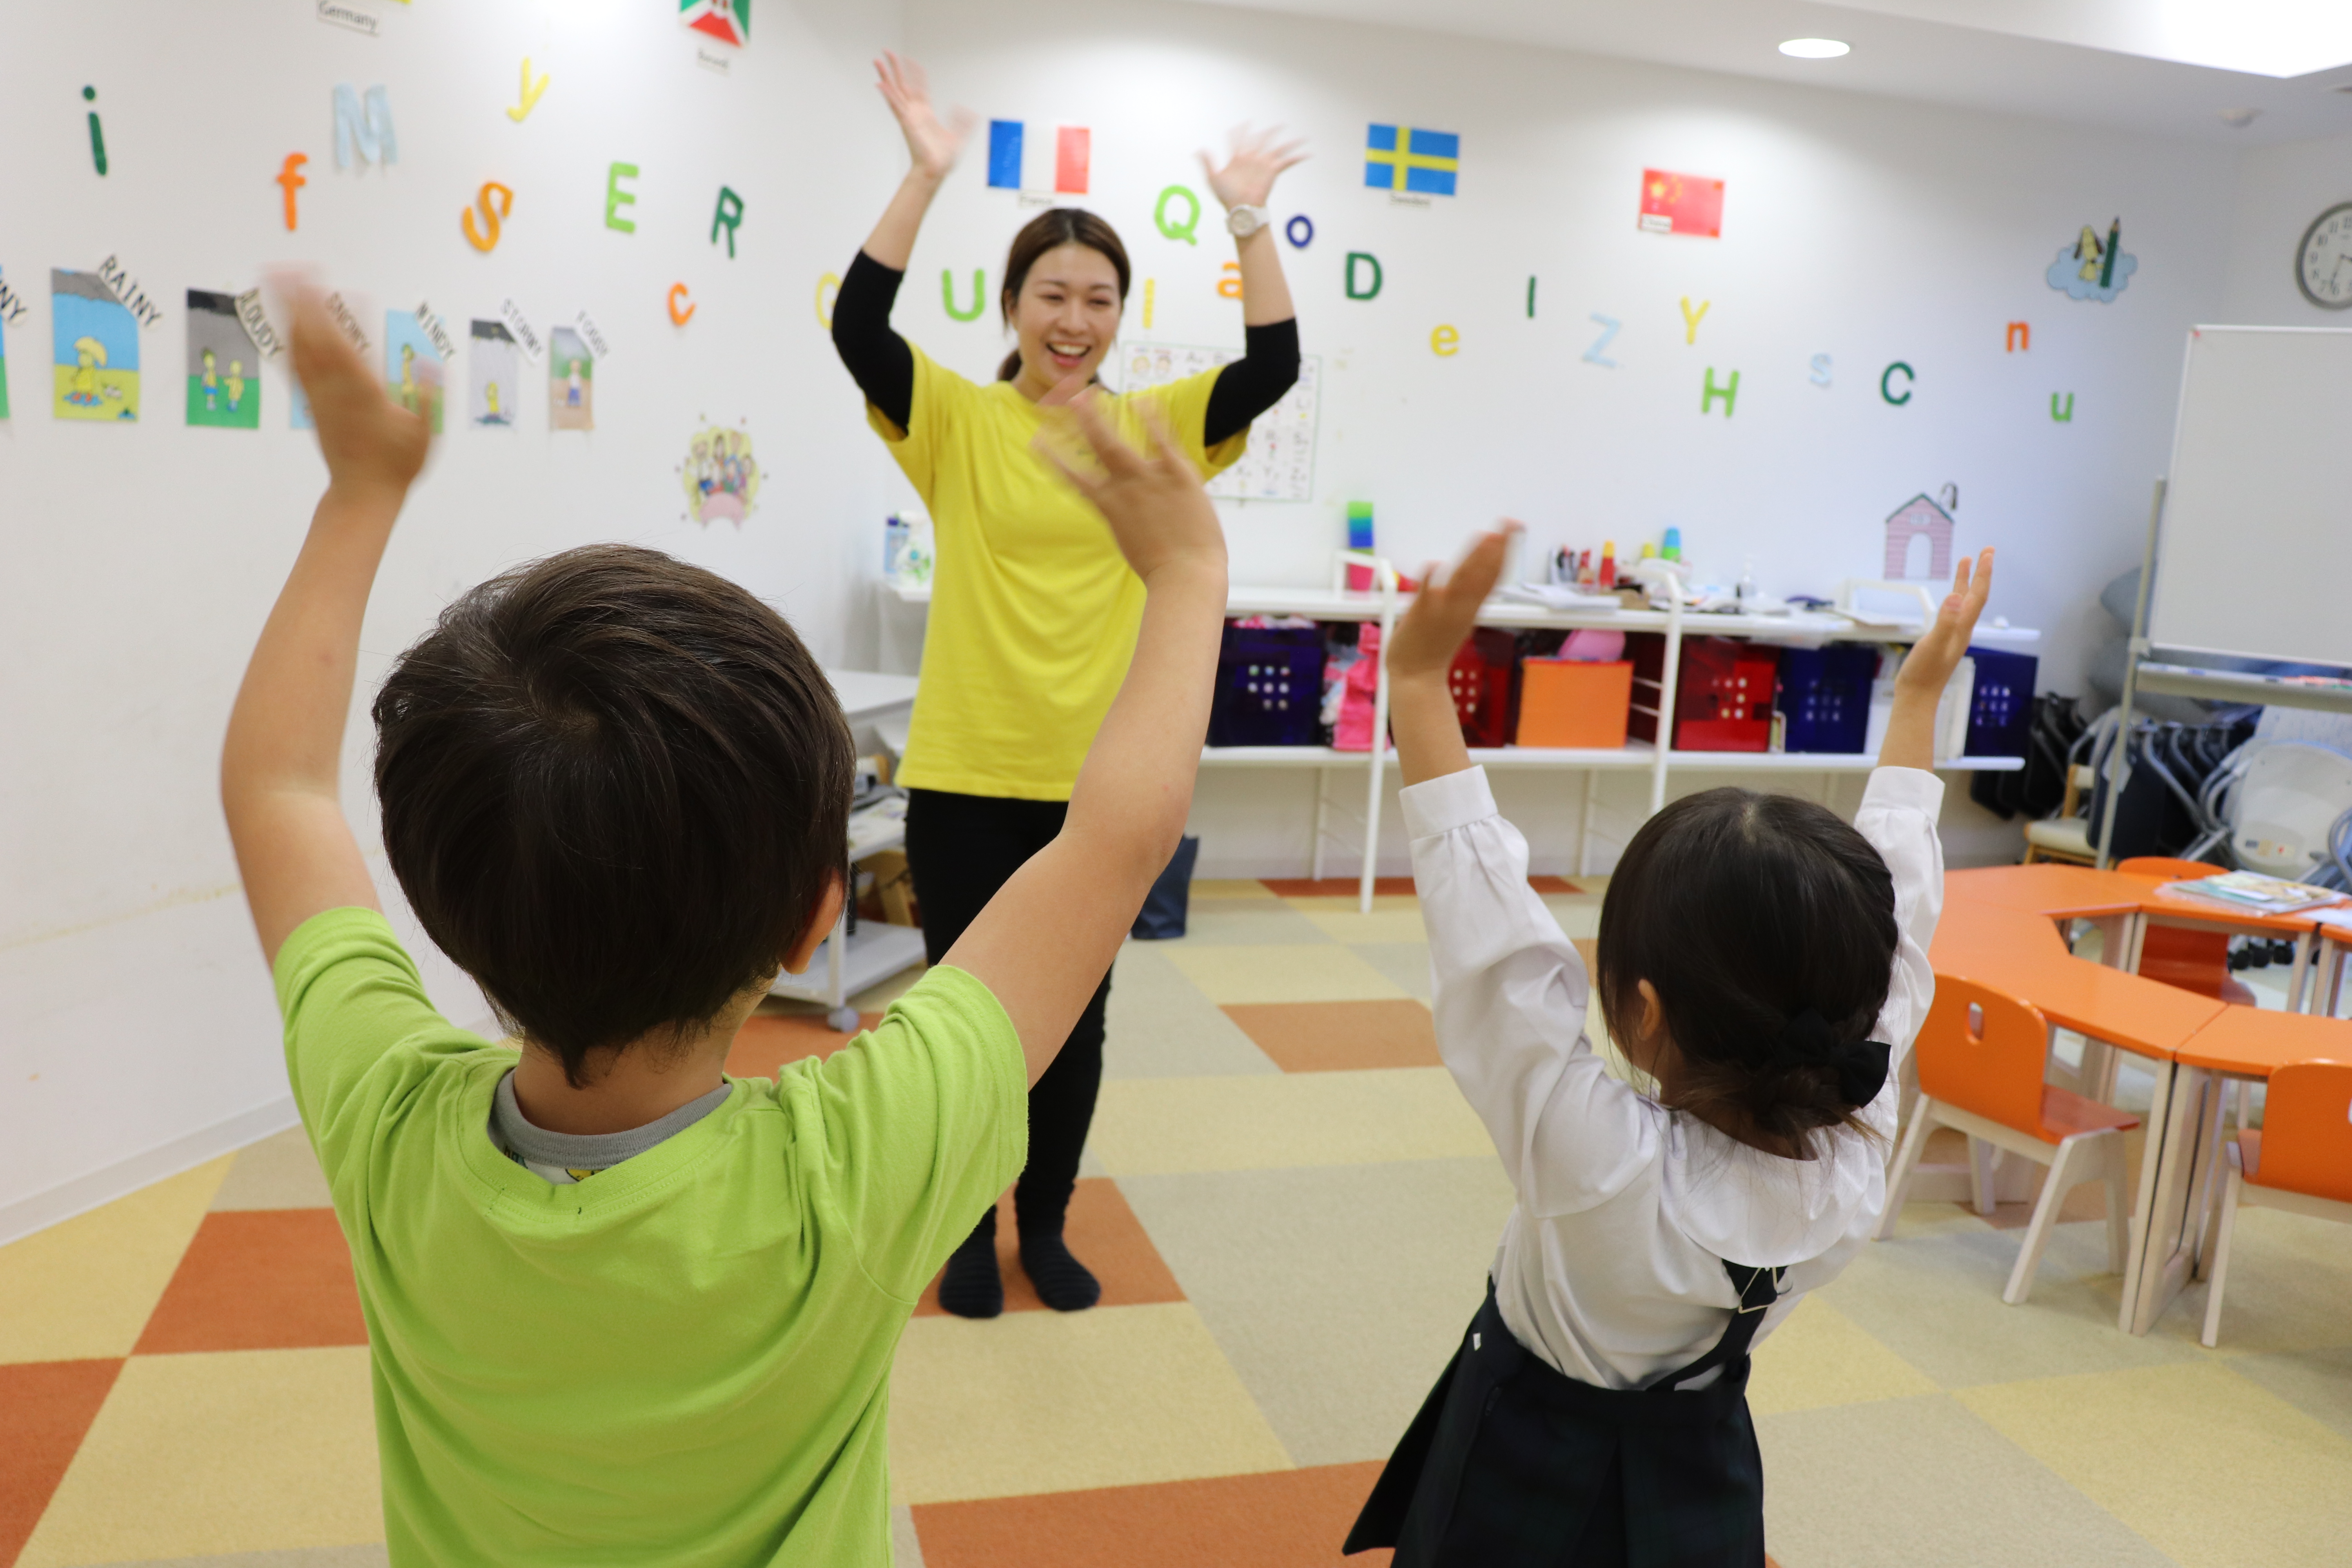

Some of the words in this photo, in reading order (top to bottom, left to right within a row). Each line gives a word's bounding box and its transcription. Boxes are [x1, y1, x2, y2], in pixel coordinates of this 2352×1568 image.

[82, 85, 107, 176] i
[332, 82, 399, 169] M
[276, 153, 307, 231] f
[462, 182, 513, 253] S
[605, 162, 639, 234] E
[1154, 185, 1200, 246] Q
[711, 186, 744, 258] R
[0, 280, 27, 320] NY
[100, 255, 162, 325] RAINY
[942, 269, 985, 322] U
[1217, 261, 1243, 301] a
[1345, 252, 1383, 301] D
[1430, 325, 1459, 356] e
[1681, 296, 1710, 345] Y
[2007, 322, 2029, 352] n
[1702, 368, 1739, 417] H
[2051, 393, 2074, 422] u
